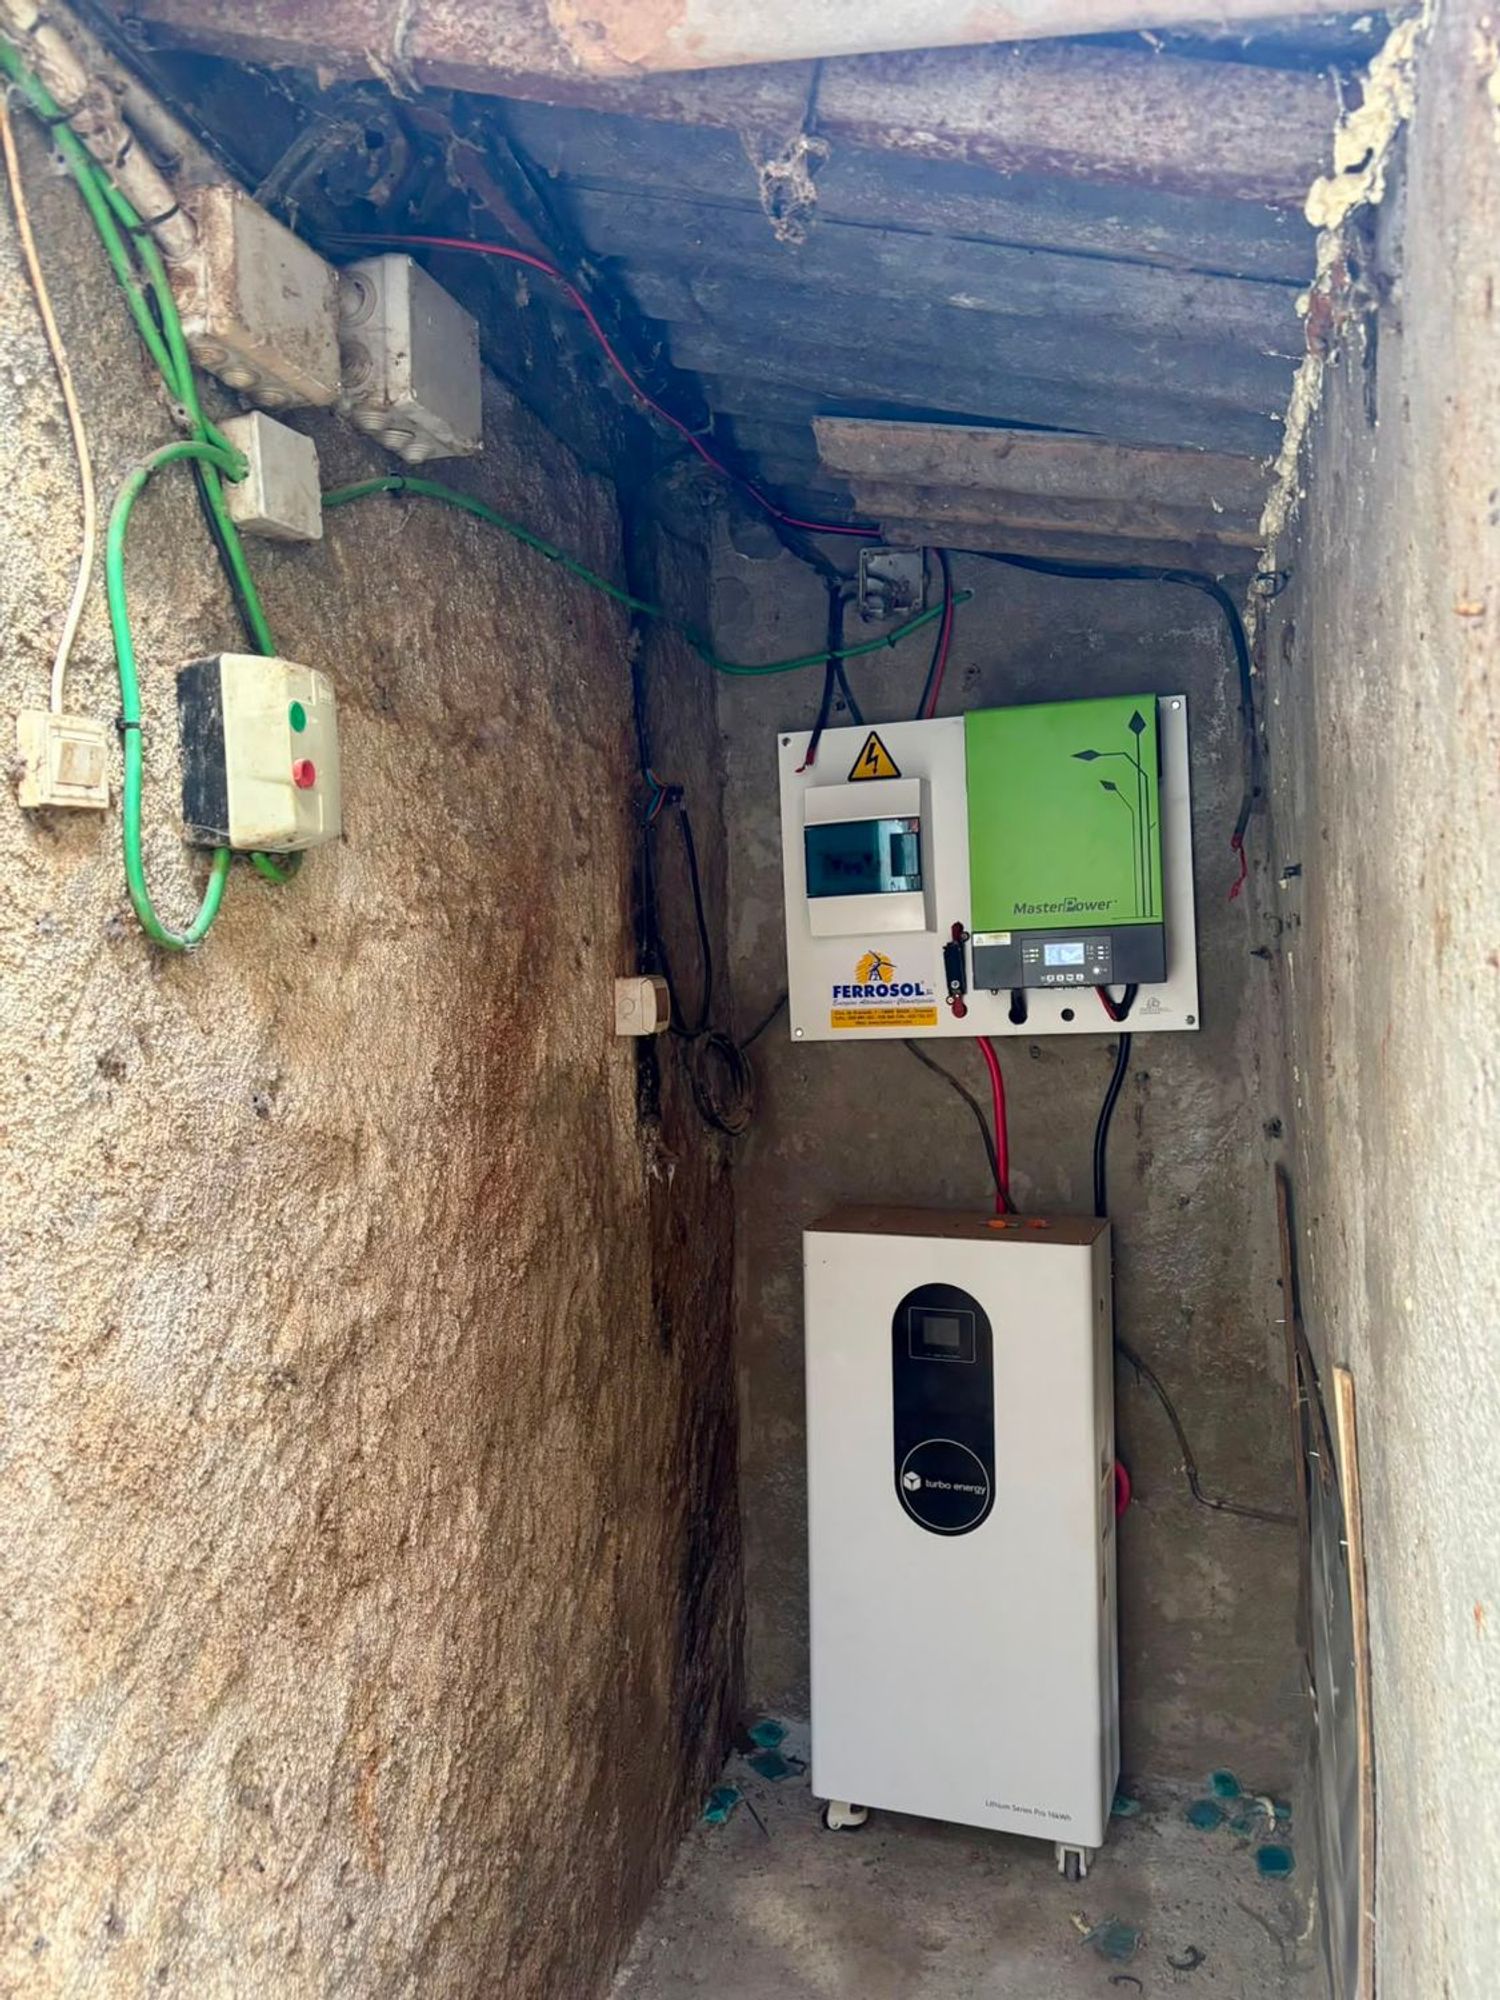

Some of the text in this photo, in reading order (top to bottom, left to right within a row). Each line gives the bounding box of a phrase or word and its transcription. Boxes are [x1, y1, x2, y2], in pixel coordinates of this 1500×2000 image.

[832, 983, 925, 999] FERROSOL
[925, 1479, 986, 1495] turbo energy
